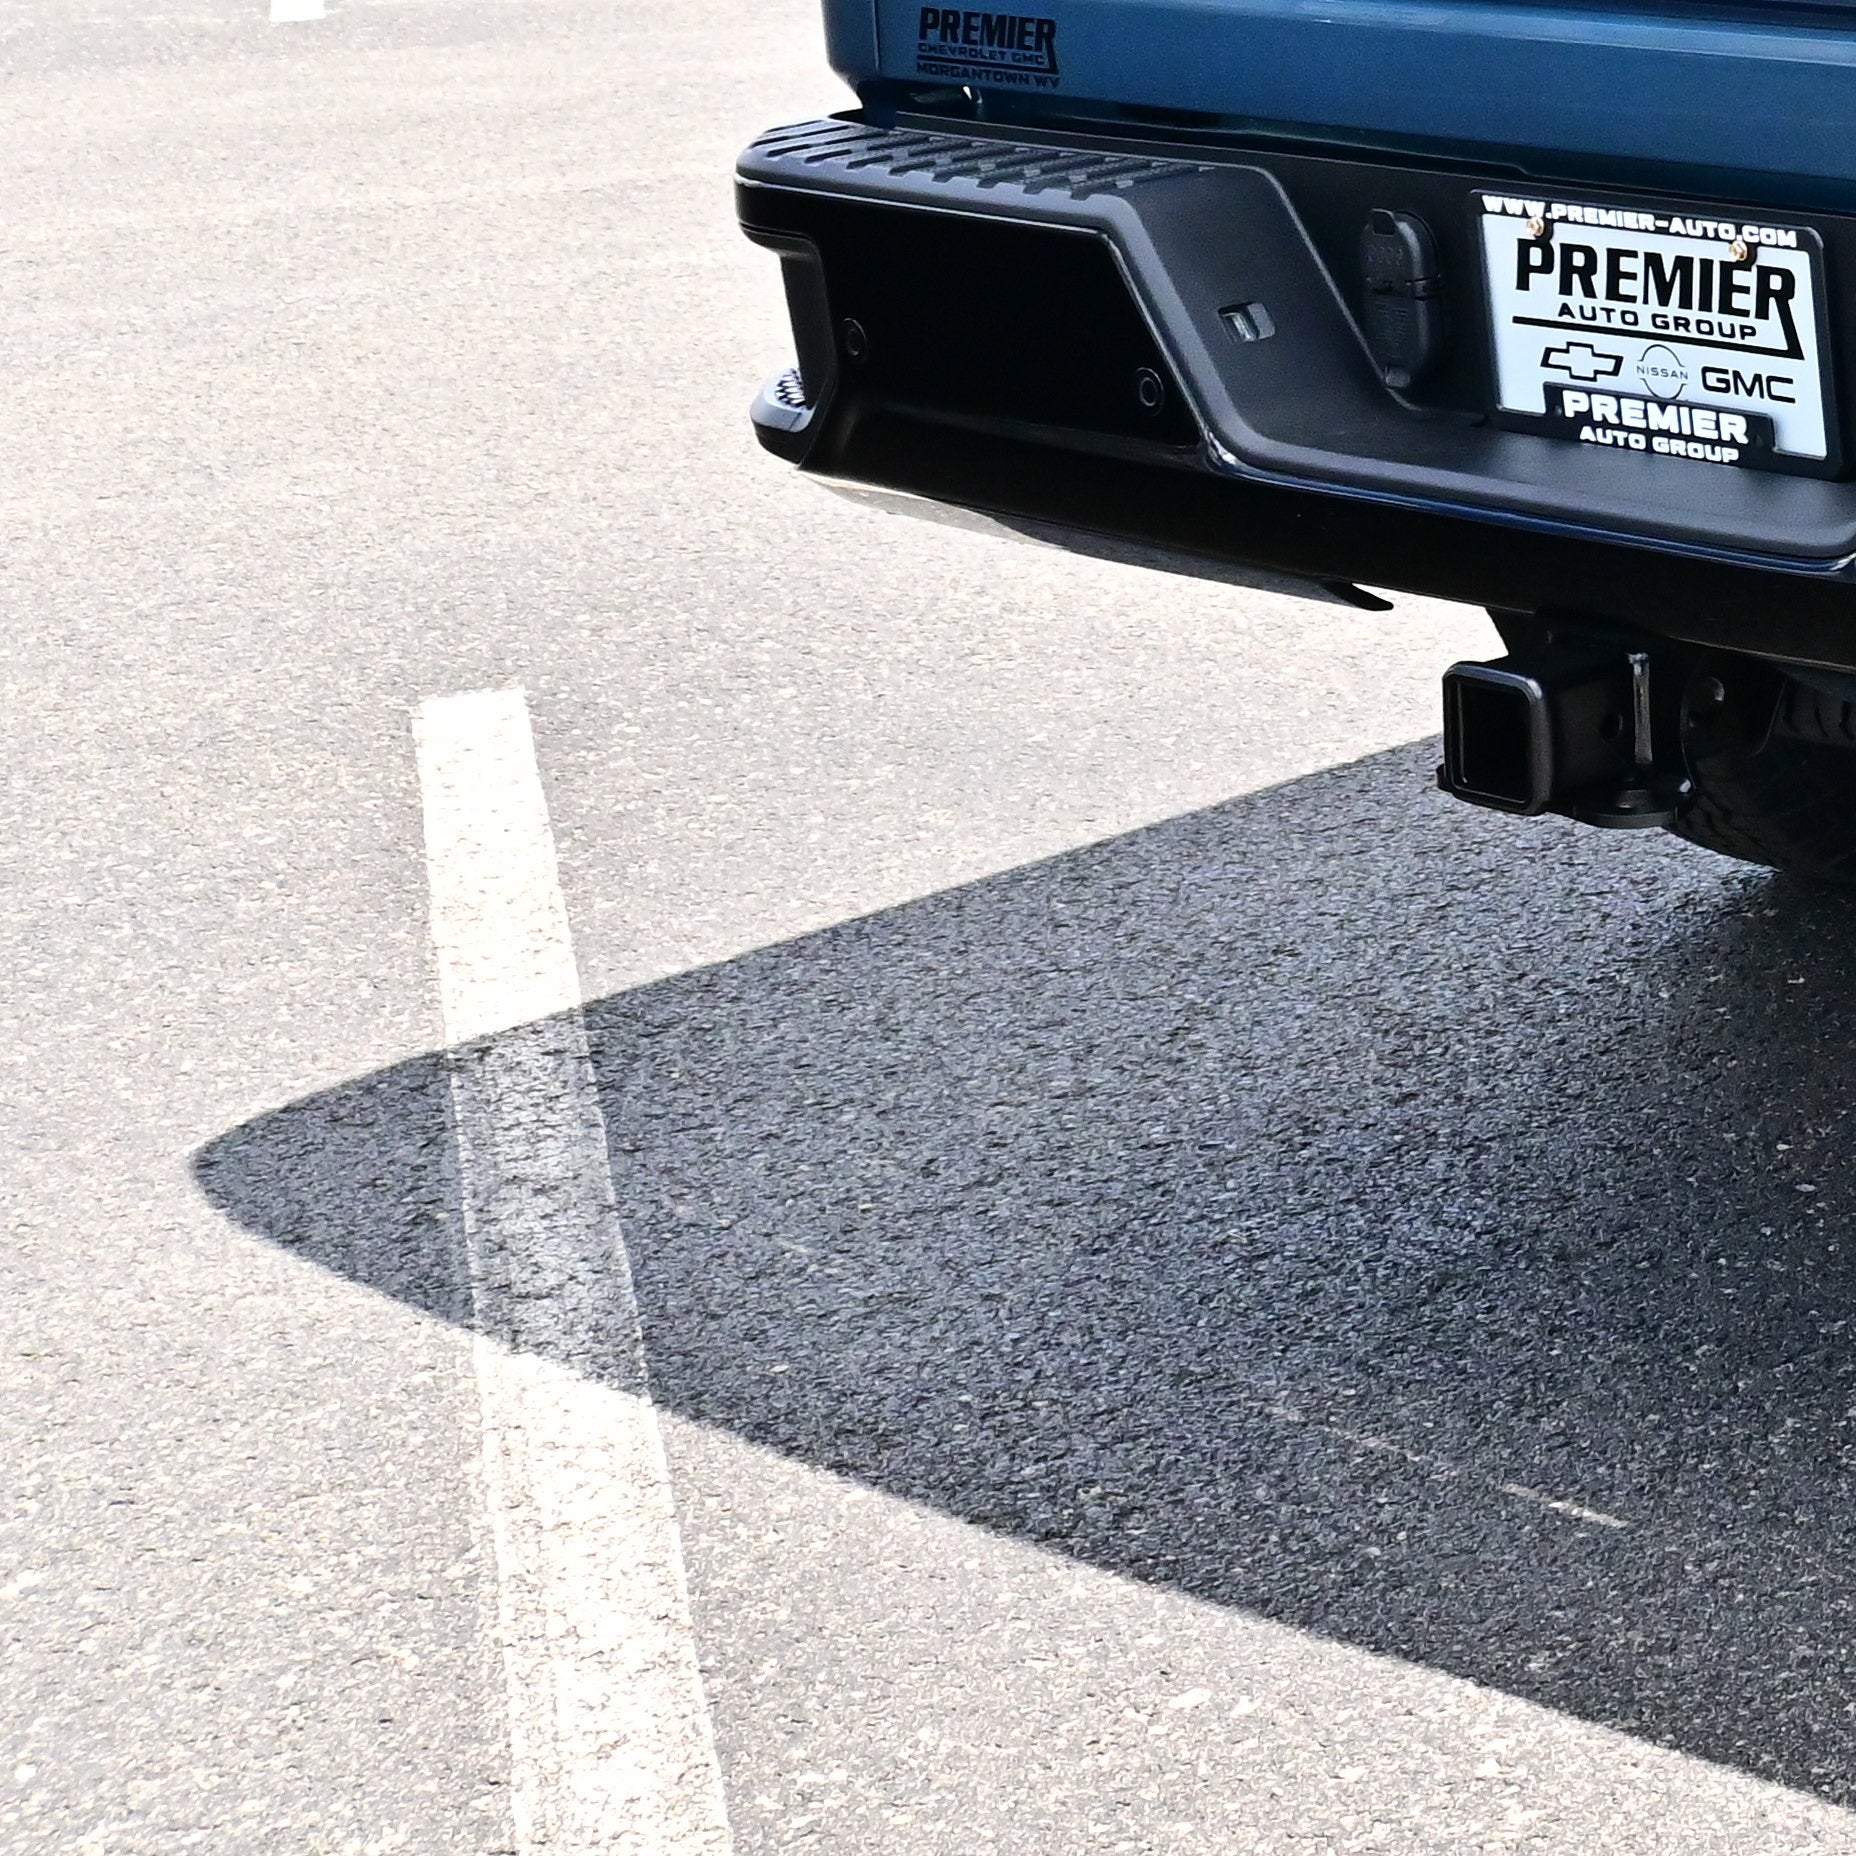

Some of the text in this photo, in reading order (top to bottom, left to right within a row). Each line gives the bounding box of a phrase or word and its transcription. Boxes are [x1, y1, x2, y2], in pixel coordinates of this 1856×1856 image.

[918, 6, 1058, 53] PREMIER
[916, 62, 1030, 85] MORGANTOWN
[917, 42, 1045, 66] CHEVROLET GMC
[1481, 194, 1797, 248] WWW.PREMIER-AUTO.COM
[1514, 237, 1798, 322] PREMIER
[1558, 301, 1758, 341] AUTO GROUP
[1635, 364, 1797, 404] NISSAN GMC
[1562, 390, 1750, 445] PREMIER
[1579, 425, 1740, 464] AUTO GROUP
